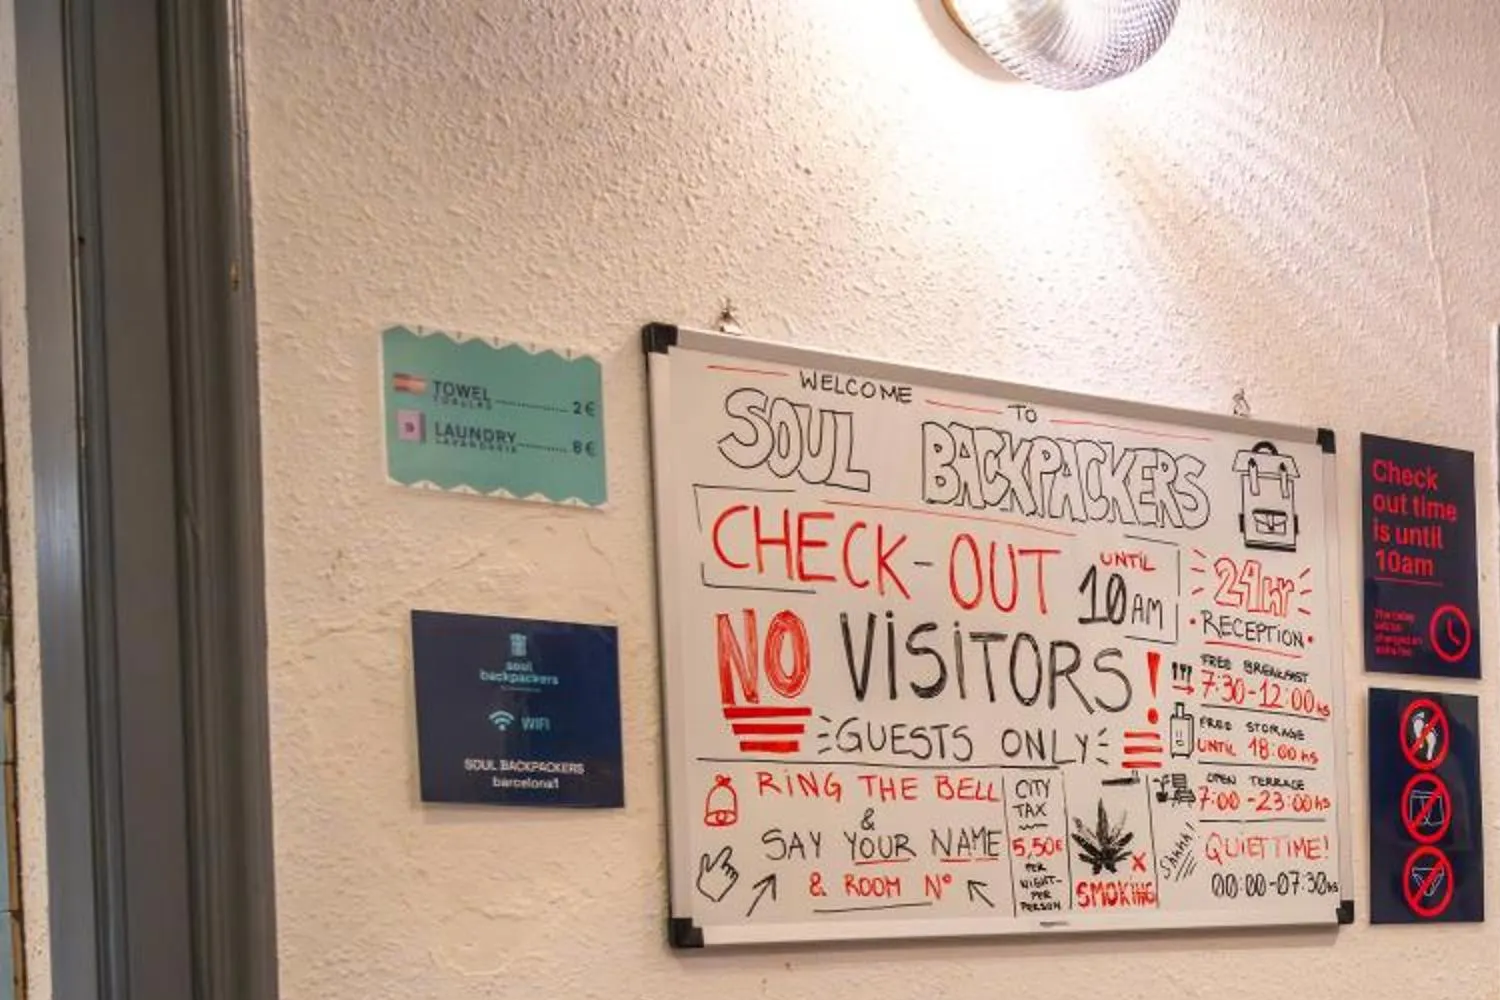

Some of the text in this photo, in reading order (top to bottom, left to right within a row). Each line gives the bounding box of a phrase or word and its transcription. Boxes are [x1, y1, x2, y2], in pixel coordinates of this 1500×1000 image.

[433, 380, 596, 418] TOWEL 2€
[800, 370, 1038, 423] WELCOME TO
[434, 421, 516, 444] LAUNDRY
[717, 387, 1211, 530] SOUL BACKPACKERS
[1372, 459, 1439, 490] Check
[1372, 493, 1458, 522] out time
[1373, 517, 1443, 549] is until
[712, 504, 1061, 615] CHECK-OUT
[1375, 549, 1435, 577] 10am
[716, 608, 811, 706] NO
[1200, 653, 1309, 683] FREE BREAKFAST
[479, 669, 560, 686] backpackers
[835, 717, 1089, 765] GUESTS ONLY
[1200, 715, 1305, 741] FREE STORAGE
[464, 758, 585, 775] SOUL BACKPACKERS
[1206, 773, 1237, 785] OPEN
[857, 774, 918, 803] THE
[934, 774, 1000, 803] BELL
[1015, 778, 1051, 799] CITY
[860, 807, 875, 831] &
[1012, 802, 1047, 819] TAX
[761, 826, 1002, 861] SAY YOUR NAME
[1025, 863, 1047, 873] PER
[809, 871, 827, 898] &
[845, 873, 901, 898] ROOM
[1031, 889, 1052, 901] PER
[1020, 901, 1061, 913] PERSON
